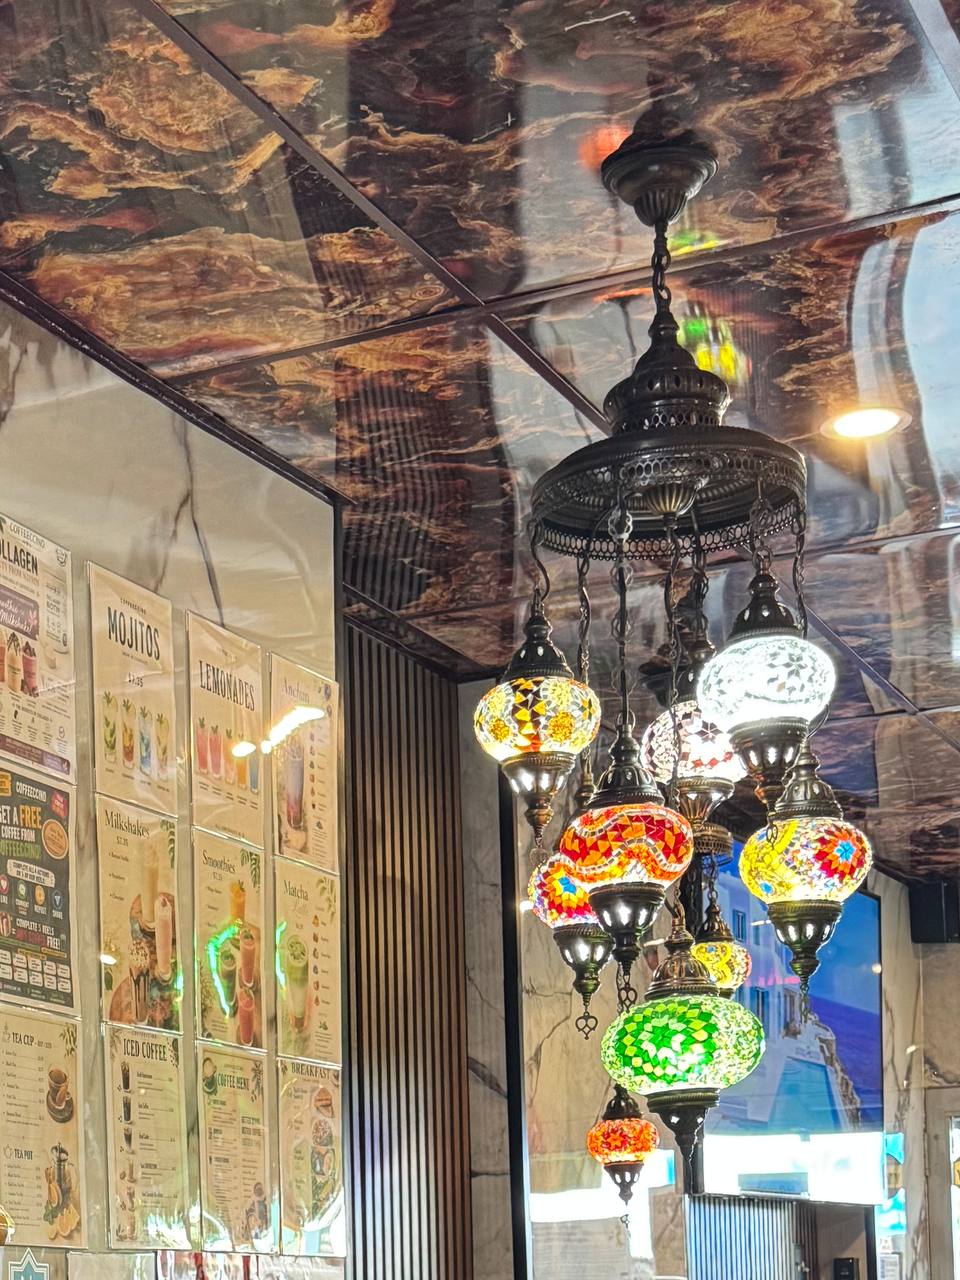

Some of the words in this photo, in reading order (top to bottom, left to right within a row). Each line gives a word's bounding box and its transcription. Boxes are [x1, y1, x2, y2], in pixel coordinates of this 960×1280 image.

[107, 605, 161, 661] MOJITOS
[199, 660, 255, 712] LEMONADES
[12, 806, 19, 826] A
[19, 804, 42, 829] FREE
[104, 809, 150, 837] Milkshakes
[1, 825, 20, 840] COFFEE
[20, 827, 36, 842] FROM
[202, 849, 237, 874] Smoothies
[283, 879, 309, 902] Matcha
[12, 1031, 23, 1046] TEA
[23, 1034, 35, 1047] CUP
[123, 1038, 140, 1057] ICED
[141, 1041, 168, 1062] COFFEE
[217, 1072, 236, 1089] COFFEE
[291, 1062, 330, 1080] BREAKFAST
[14, 1148, 24, 1159] TEA
[24, 1149, 33, 1161] POT
